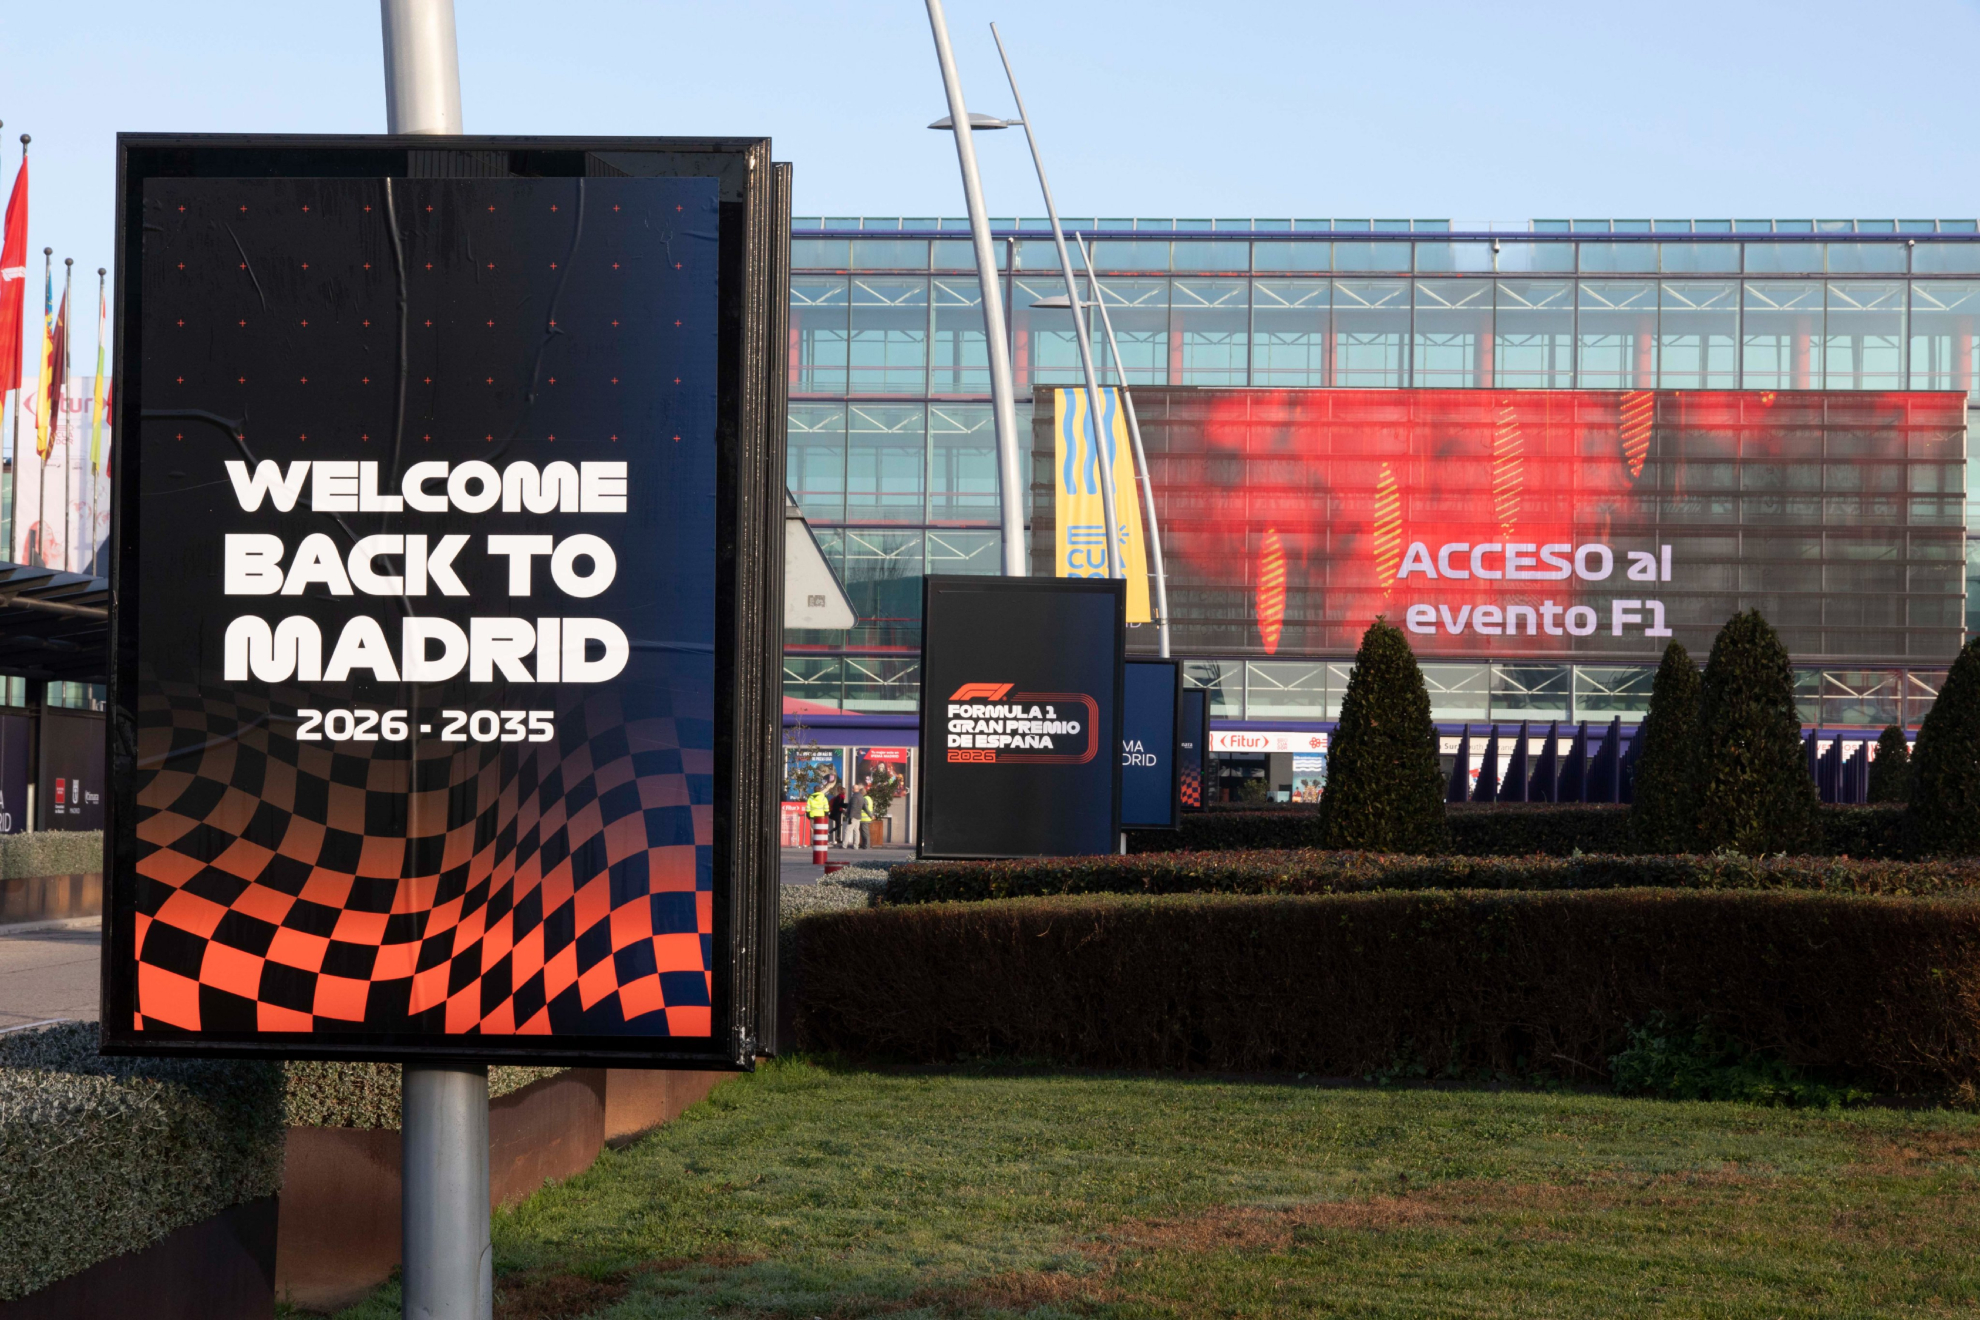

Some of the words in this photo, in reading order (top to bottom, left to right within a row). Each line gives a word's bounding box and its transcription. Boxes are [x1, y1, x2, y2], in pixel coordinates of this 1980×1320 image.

[224, 458, 628, 515] WELCOME
[224, 532, 470, 597] BACK
[487, 533, 617, 599] TO
[1396, 541, 1614, 582] ACCESO
[1627, 544, 1672, 582] al
[1405, 599, 1597, 635] evento
[1611, 599, 1673, 637] F1
[224, 614, 630, 684] MADRID
[296, 708, 408, 742] 2026
[441, 709, 554, 742] 2035
[947, 704, 1043, 719] FORMULA
[1046, 706, 1057, 719] 1
[947, 719, 1004, 734] GRAN
[1006, 720, 1081, 736] PREMIO
[947, 735, 973, 748] DE
[975, 734, 1054, 749] ESPAÑA
[948, 749, 995, 762] 2026
[1230, 735, 1260, 748] Fitur
